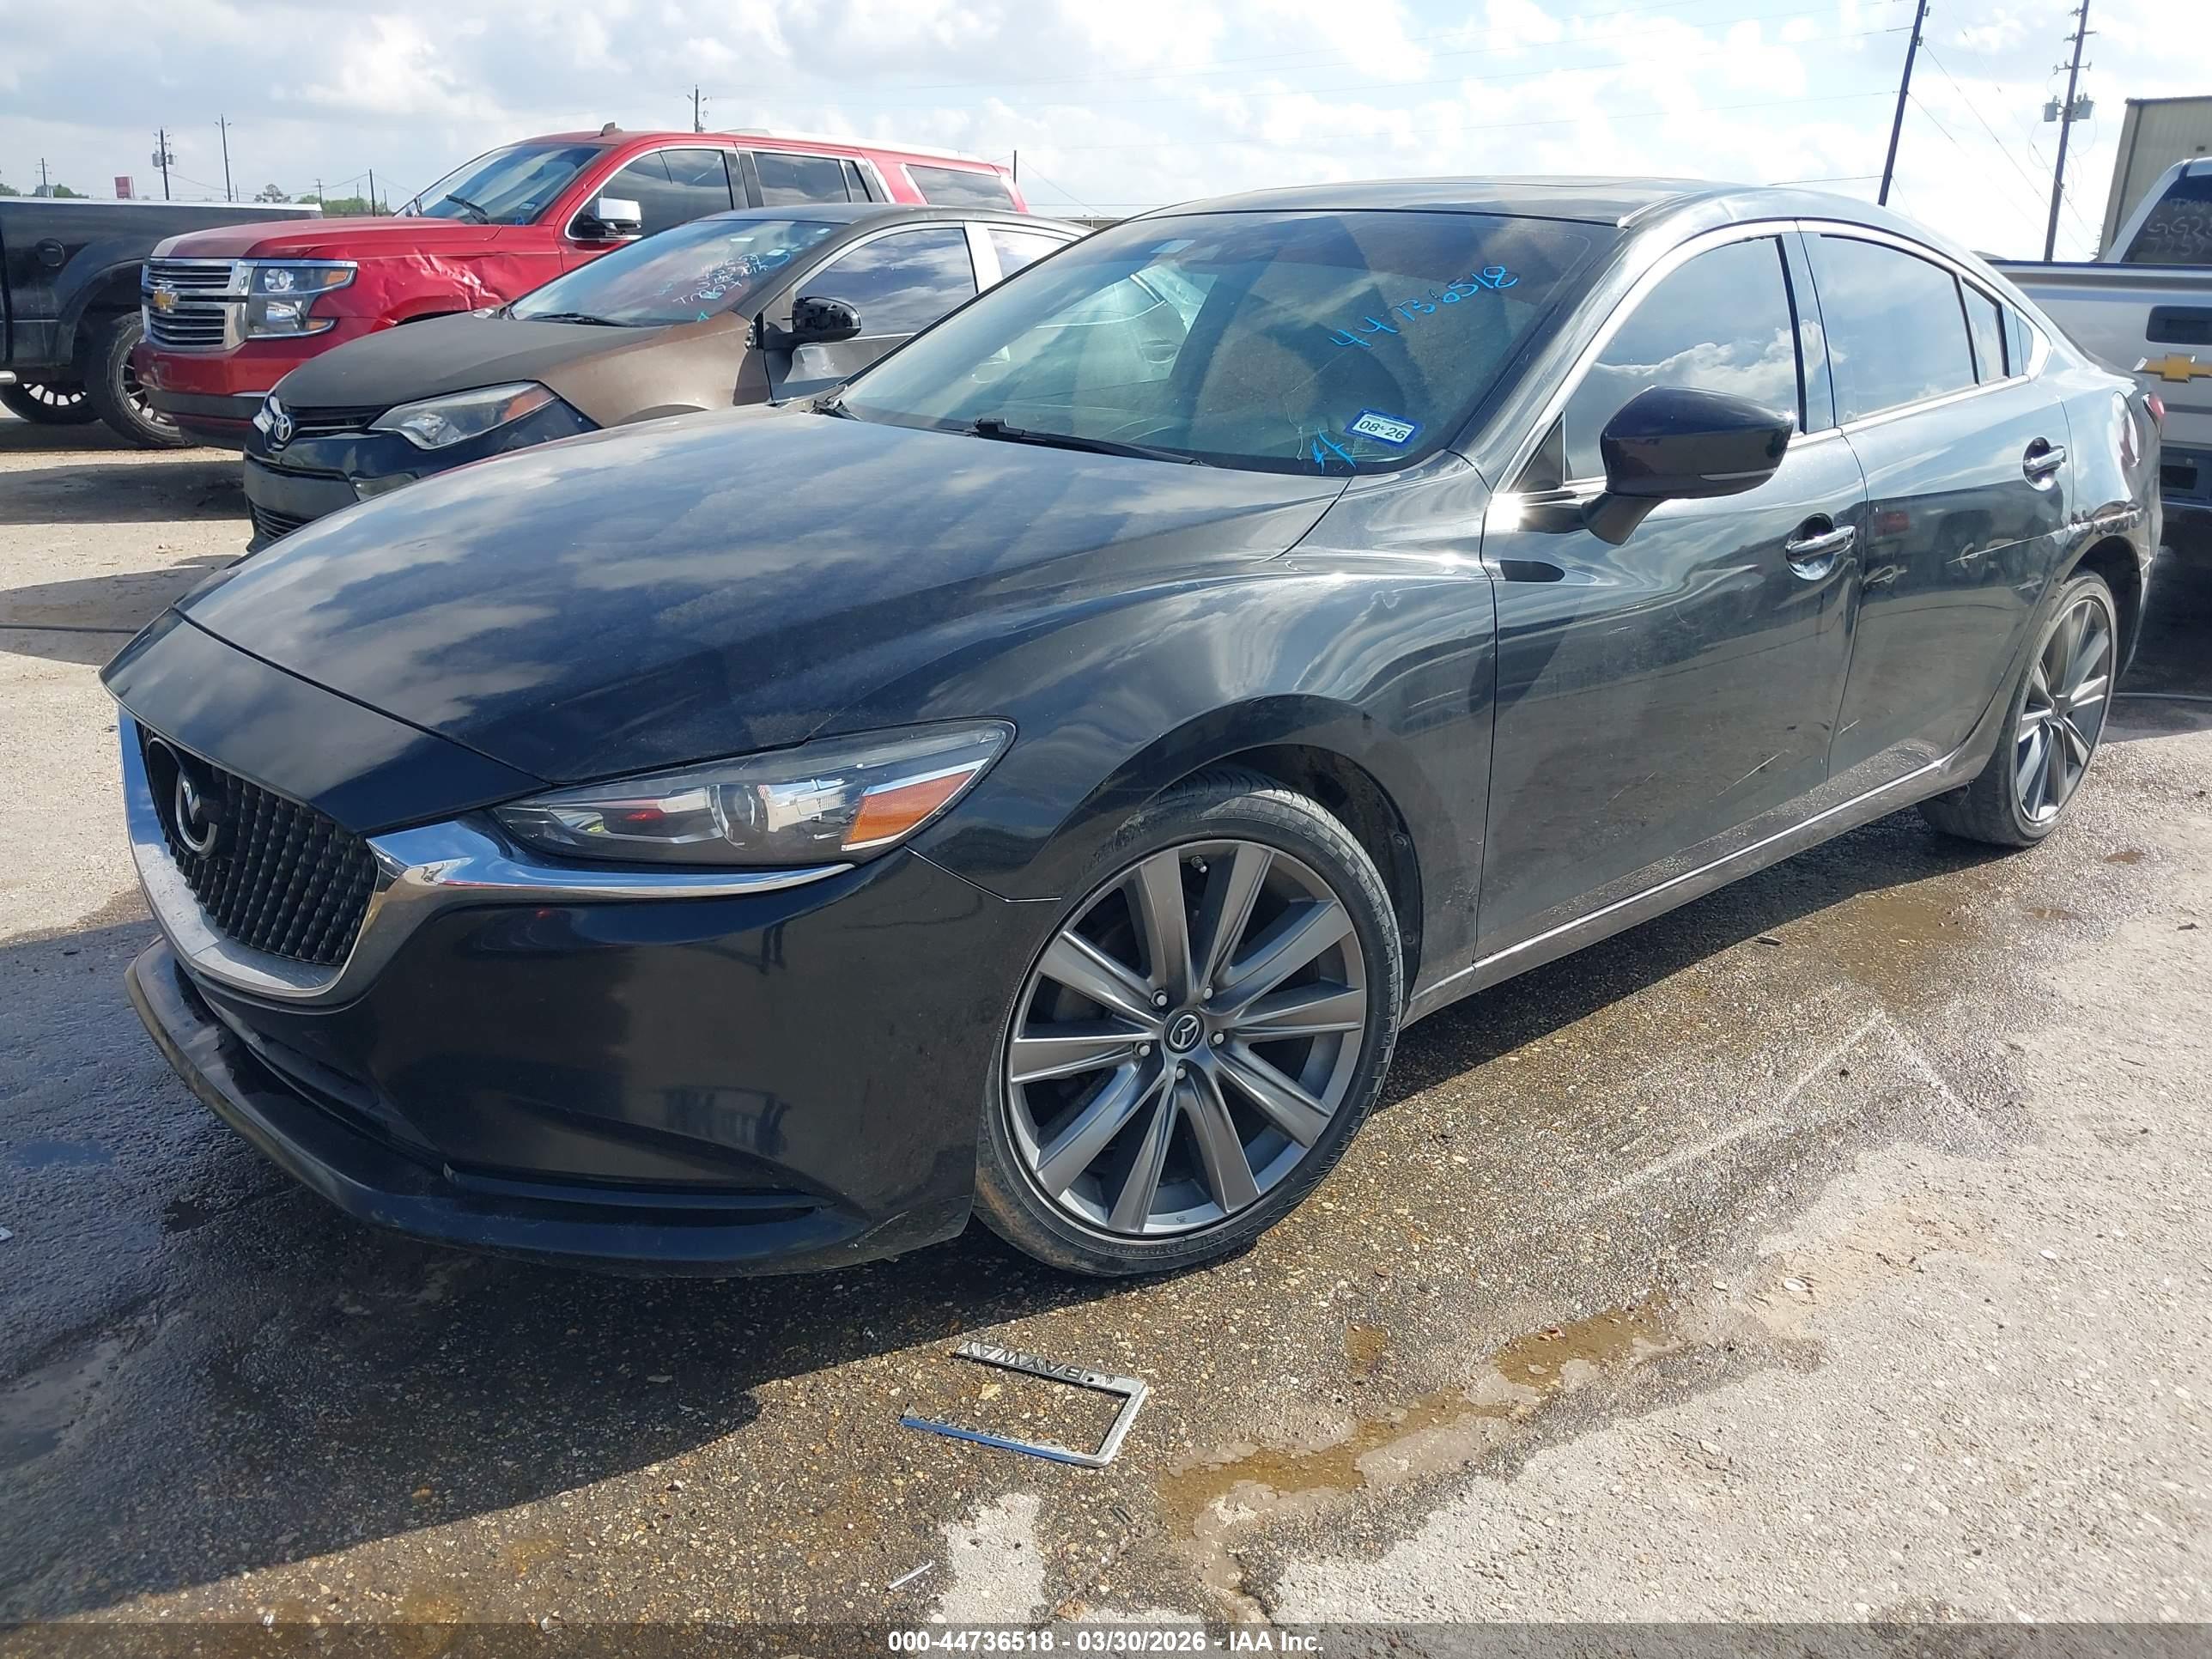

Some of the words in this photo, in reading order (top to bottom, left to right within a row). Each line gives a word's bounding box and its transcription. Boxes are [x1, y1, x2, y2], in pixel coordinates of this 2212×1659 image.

[1358, 420, 1381, 433] 08
[1384, 427, 1407, 441] 26
[960, 1340, 1084, 1381] BAYWAY
